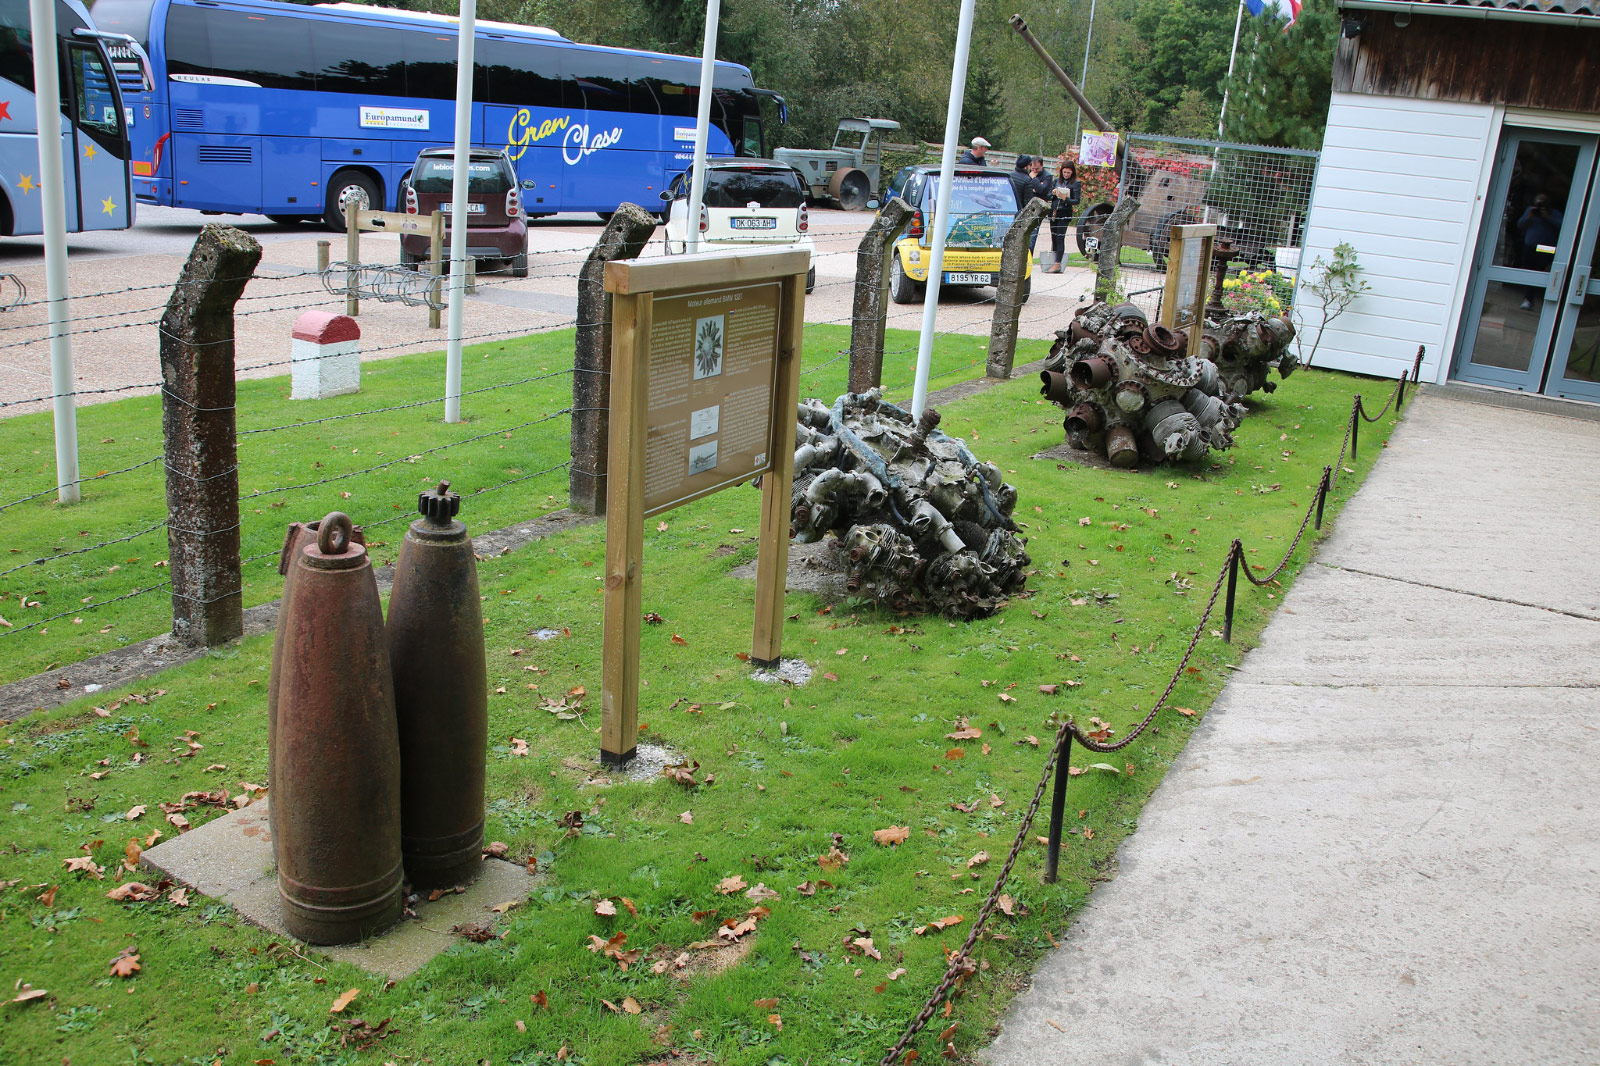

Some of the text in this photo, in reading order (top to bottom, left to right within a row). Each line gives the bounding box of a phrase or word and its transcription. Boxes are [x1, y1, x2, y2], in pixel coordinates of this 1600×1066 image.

[505, 108, 570, 161] Gran
[562, 124, 623, 165] Clase
[950, 273, 989, 283] 8195 YR 62
